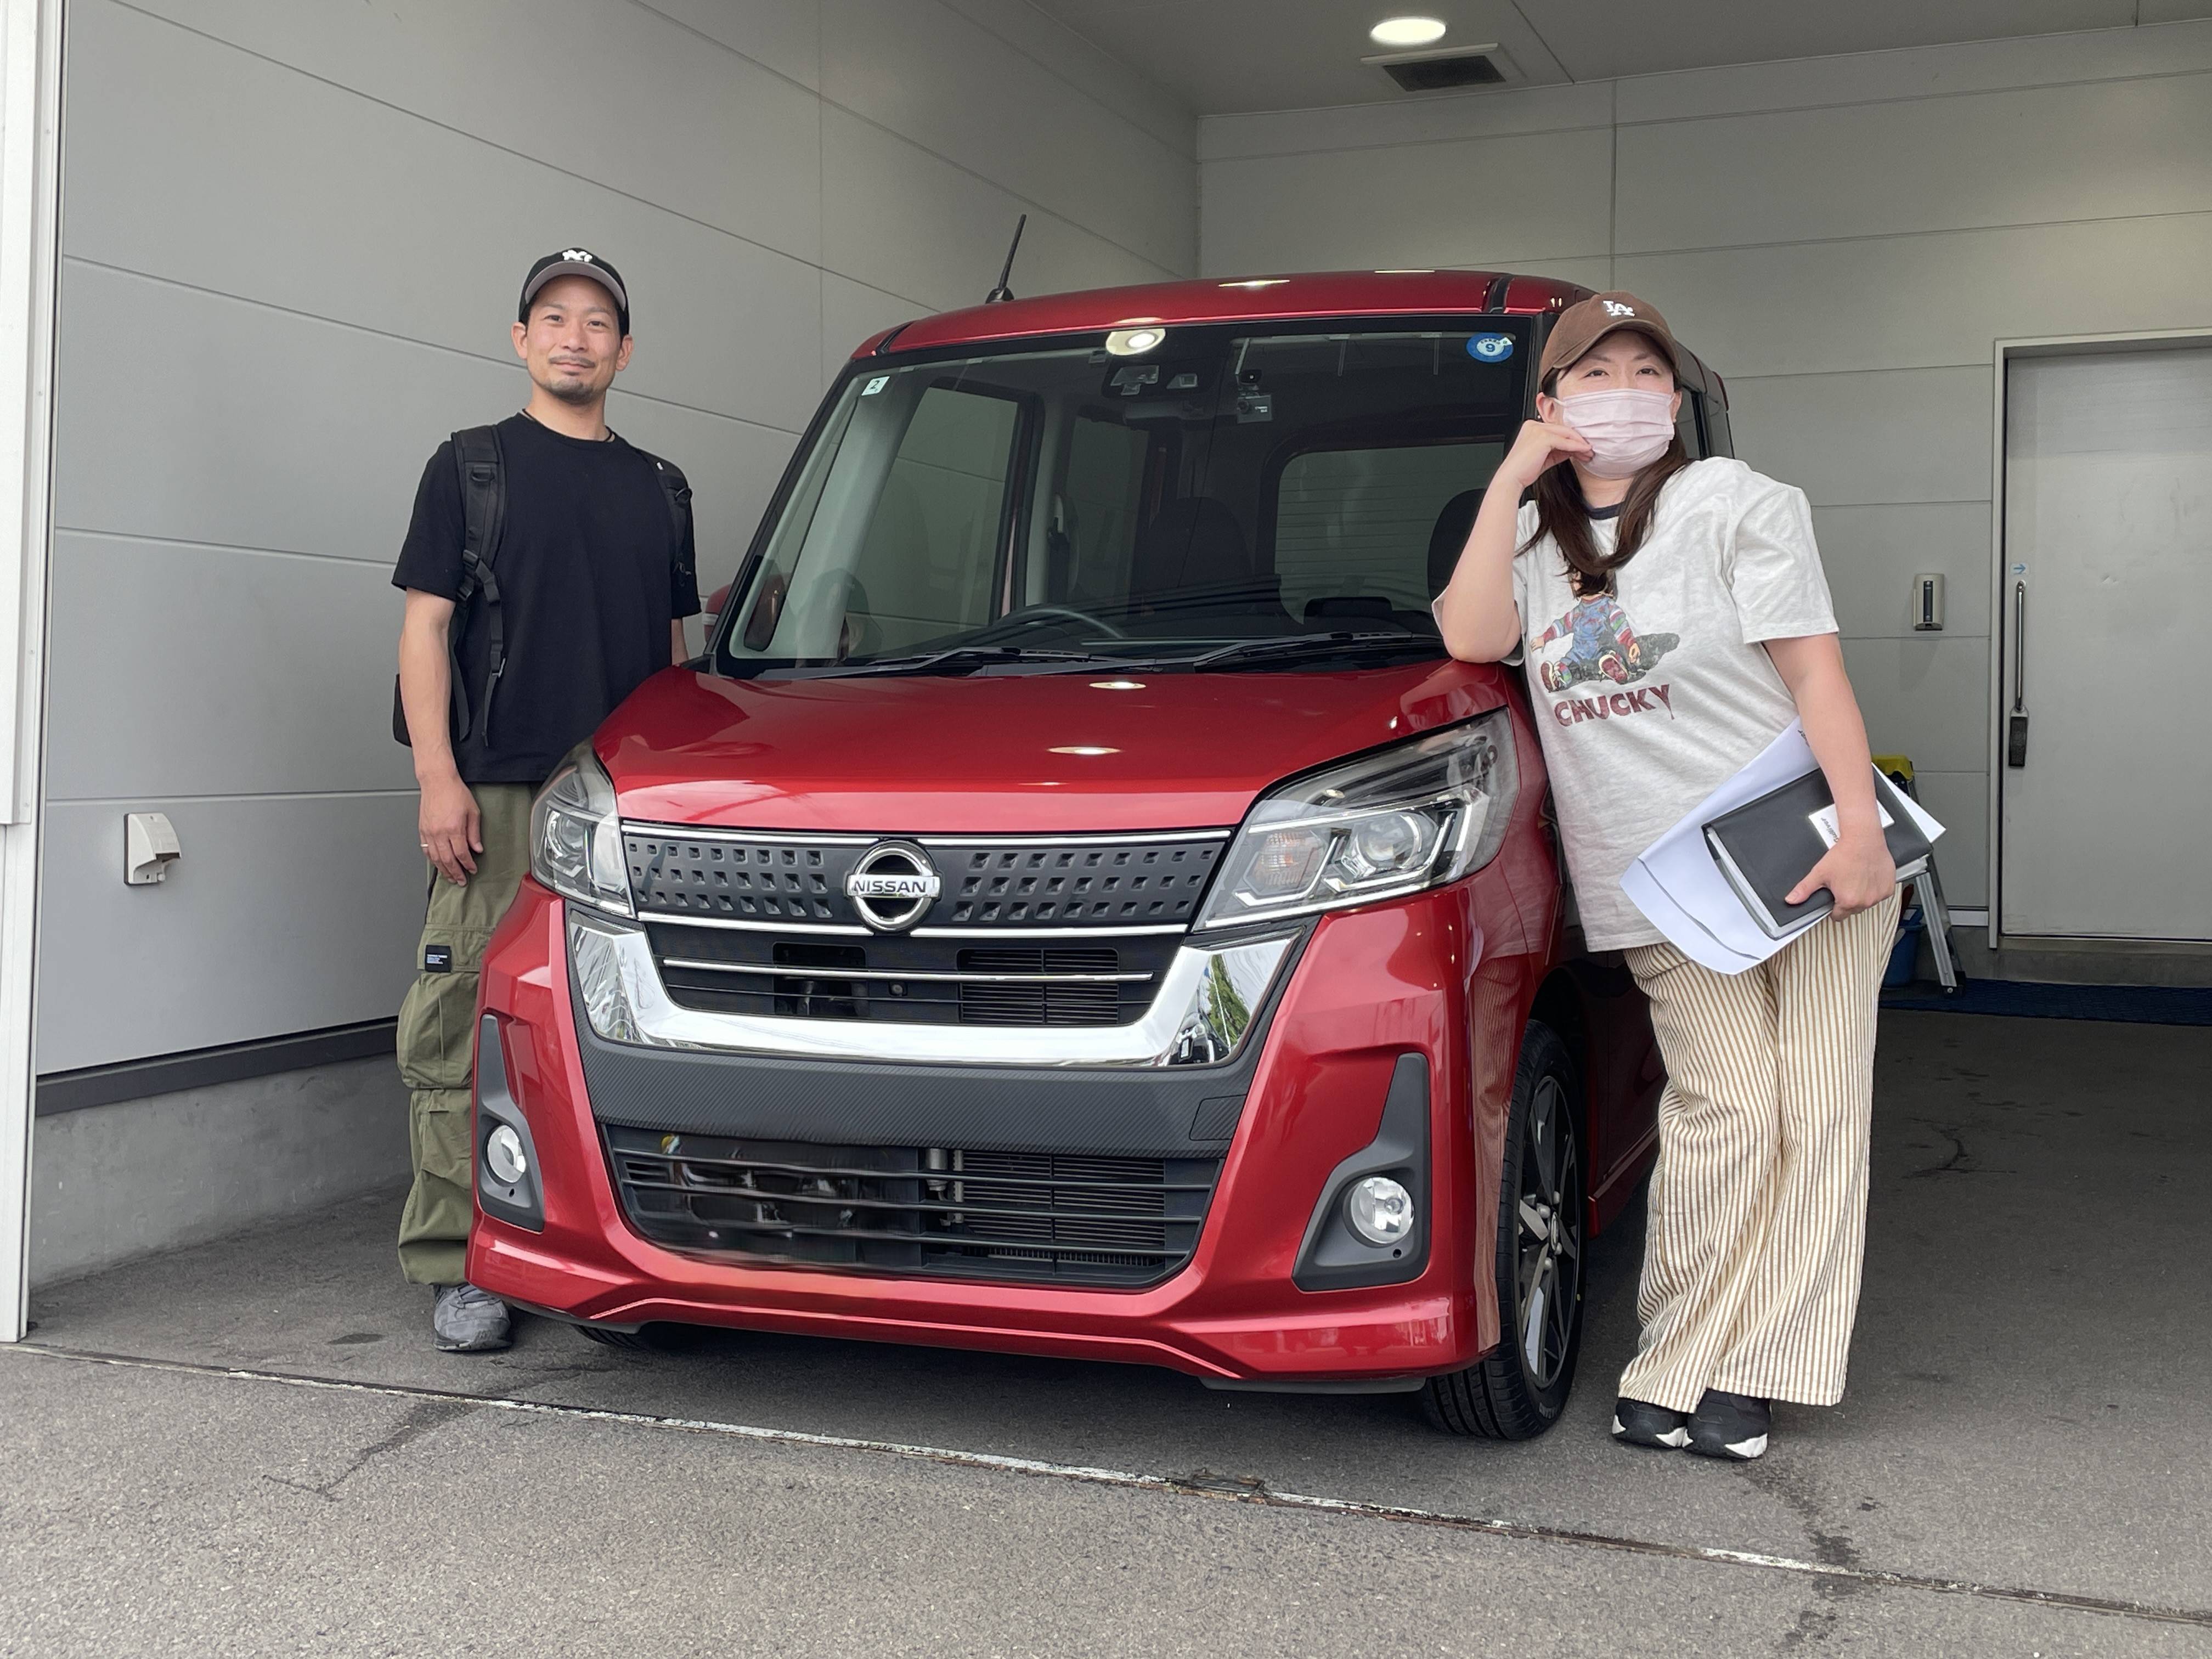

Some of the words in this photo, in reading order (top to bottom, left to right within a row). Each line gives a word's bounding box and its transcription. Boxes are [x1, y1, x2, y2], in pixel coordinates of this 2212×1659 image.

[1603, 300, 1635, 317] LA
[1485, 343, 1496, 352] 9
[1554, 684, 1674, 727] CHUCKY
[853, 880, 927, 893] NISSAN
